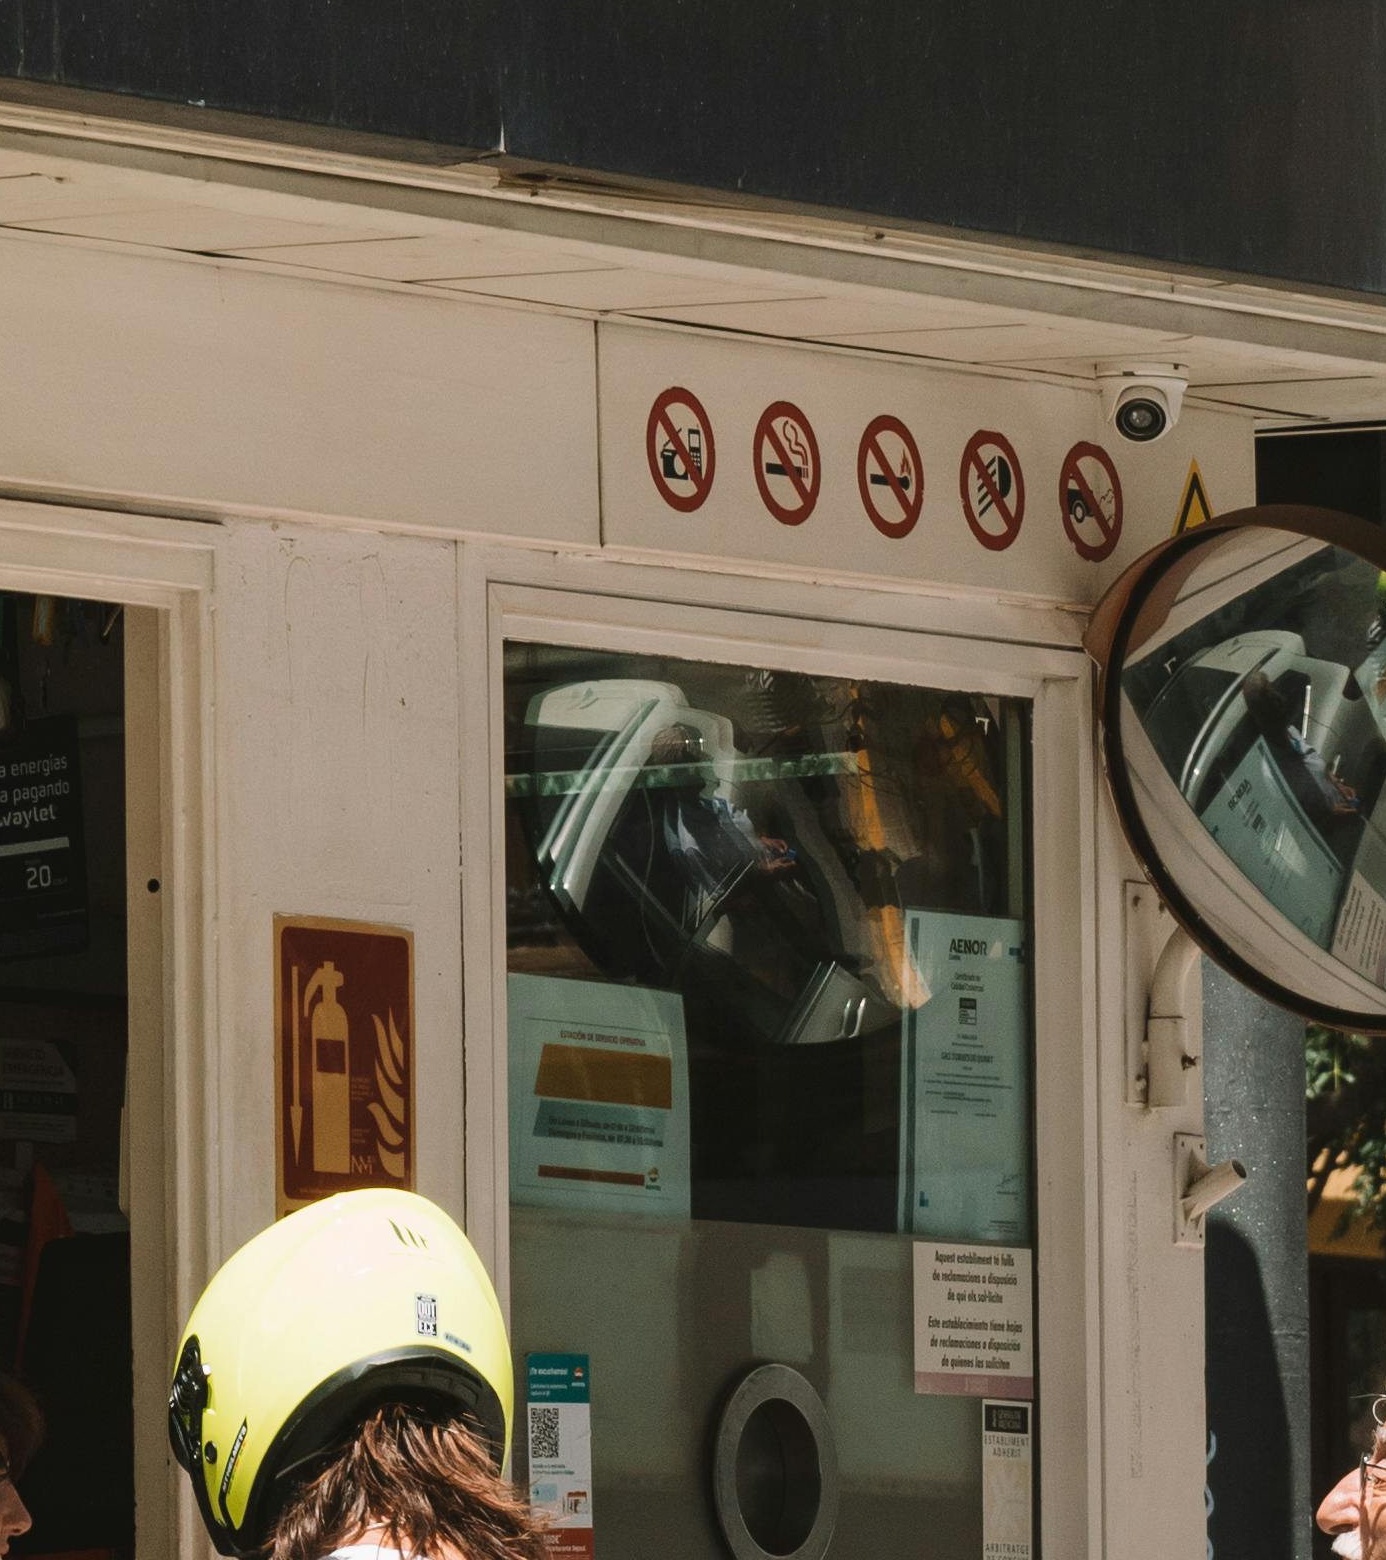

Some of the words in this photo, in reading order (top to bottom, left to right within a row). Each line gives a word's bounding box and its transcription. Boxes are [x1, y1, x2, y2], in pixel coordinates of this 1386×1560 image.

[11, 753, 68, 777] energías
[13, 779, 70, 806] pagando
[26, 864, 53, 890] 20
[949, 938, 987, 956] AENOR
[935, 1250, 956, 1265] Aquest
[957, 1251, 993, 1265] establiment
[932, 1269, 940, 1281] de
[941, 1270, 981, 1284] reclamacions
[947, 1288, 955, 1301] de
[956, 1290, 966, 1304] qui
[928, 1315, 941, 1329] Este
[941, 1316, 989, 1331] establecimiento
[990, 1319, 1006, 1333] tiene
[1006, 1319, 1023, 1336] hojas
[930, 1334, 938, 1347] de
[939, 1335, 982, 1350] reclamaciones
[941, 1354, 949, 1367] de
[950, 1355, 974, 1370] quienes
[975, 1356, 984, 1369] las
